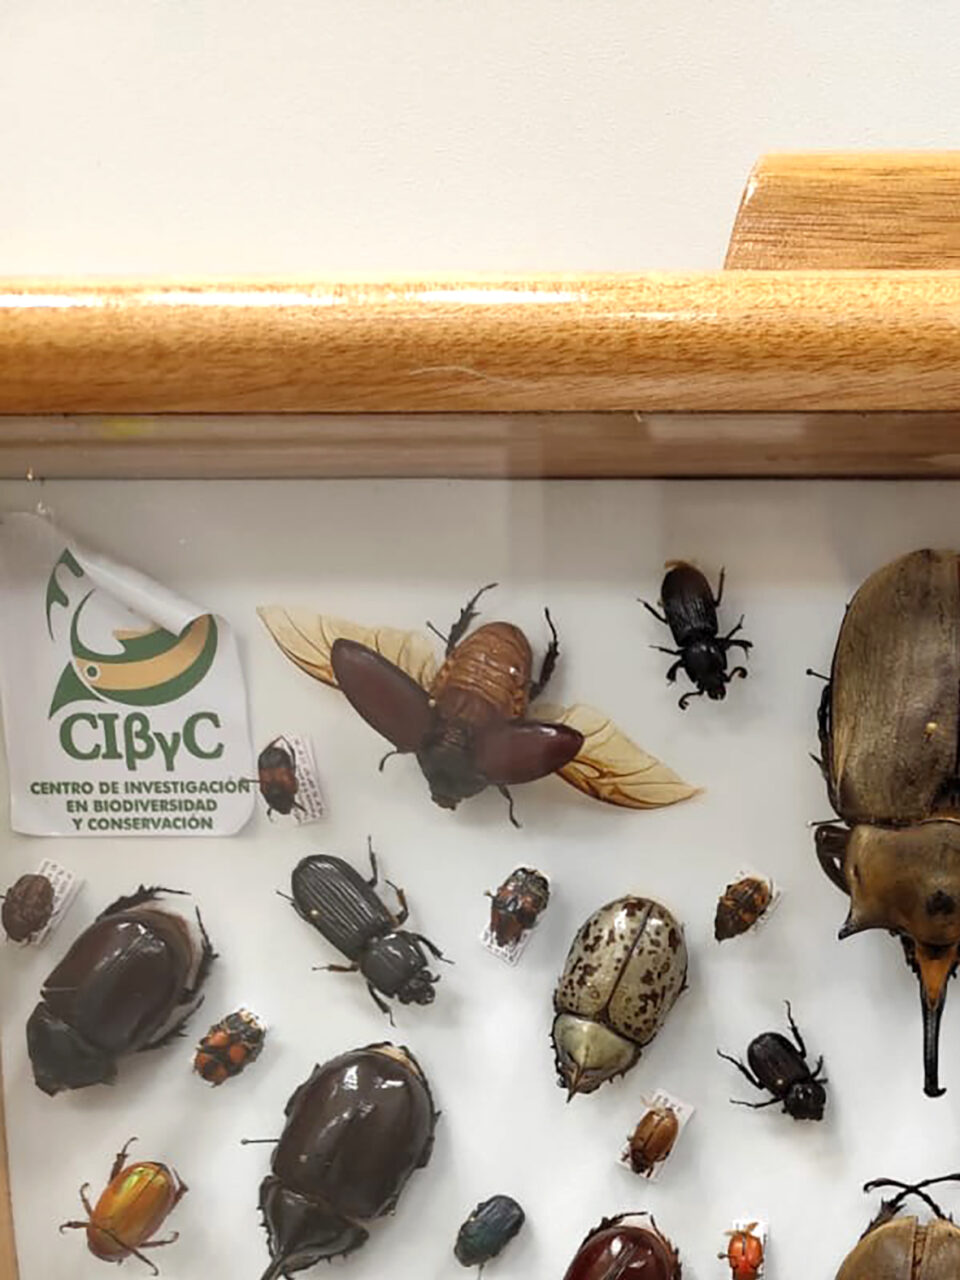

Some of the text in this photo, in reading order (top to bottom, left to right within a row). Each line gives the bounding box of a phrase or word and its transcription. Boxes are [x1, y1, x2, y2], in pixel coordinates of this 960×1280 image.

[30, 776, 250, 795] CENTRO DE INVESTIGACIÓN
[66, 800, 217, 812] EN BIODIVERSIDAD
[72, 814, 213, 830] Y CONSERVACIÓN
